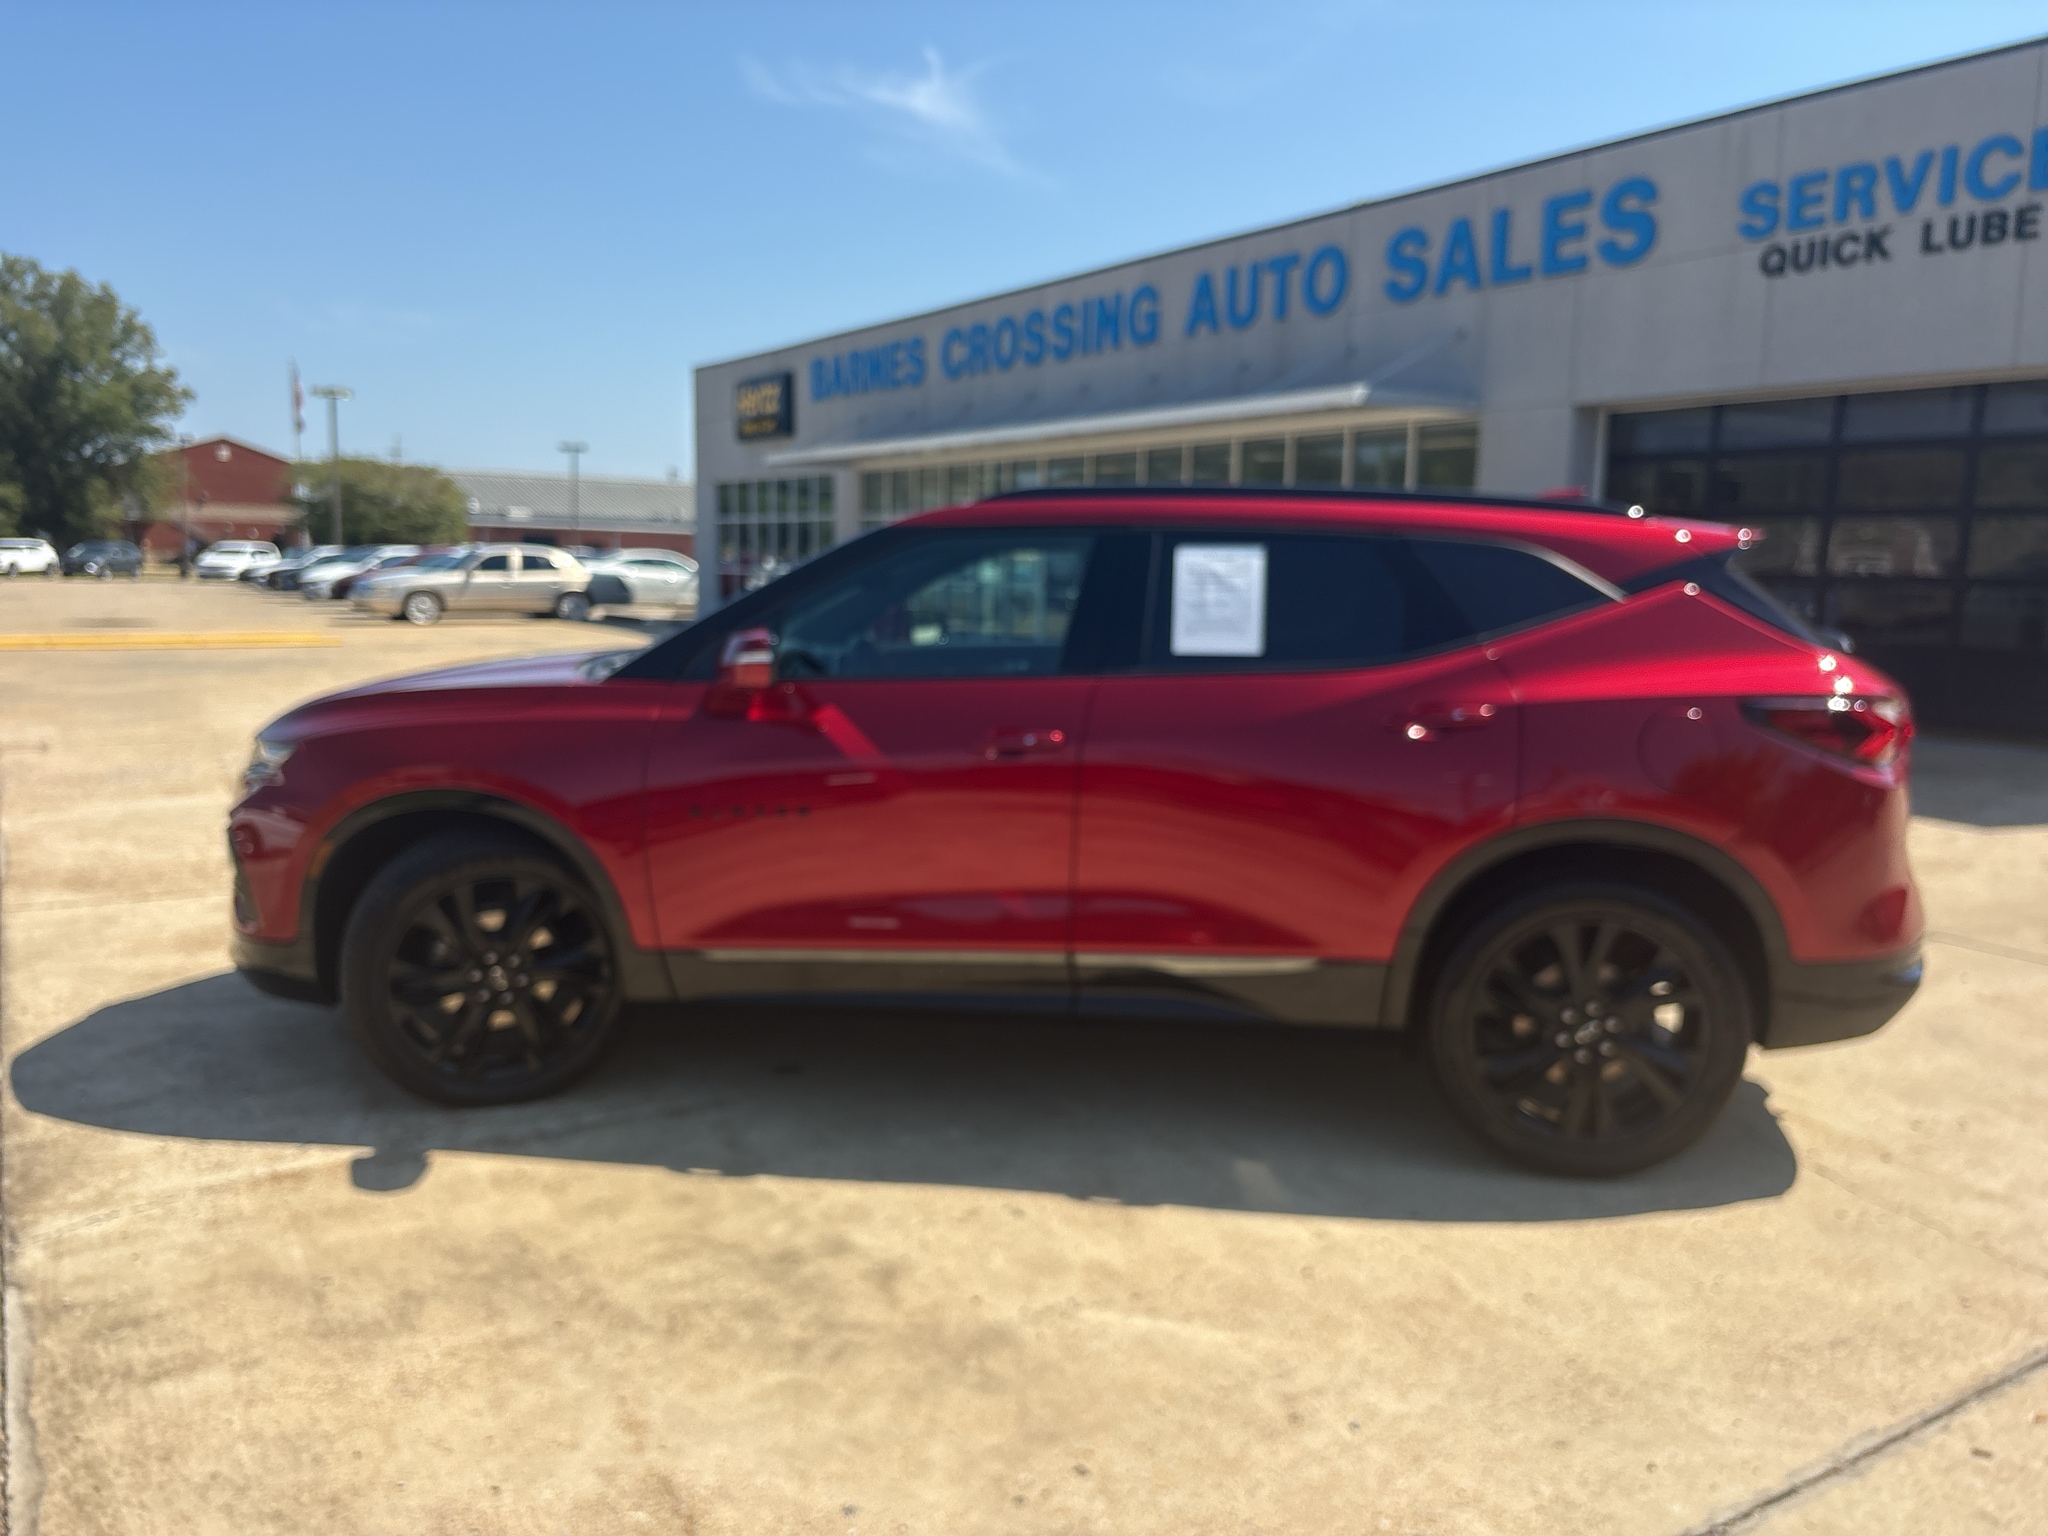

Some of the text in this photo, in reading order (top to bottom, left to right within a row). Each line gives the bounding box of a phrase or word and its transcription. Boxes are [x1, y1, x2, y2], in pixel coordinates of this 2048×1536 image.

[810, 176, 1659, 400] BARNES CROSSING AUTO SALES
[1759, 203, 2041, 277] QUICK LUBE
